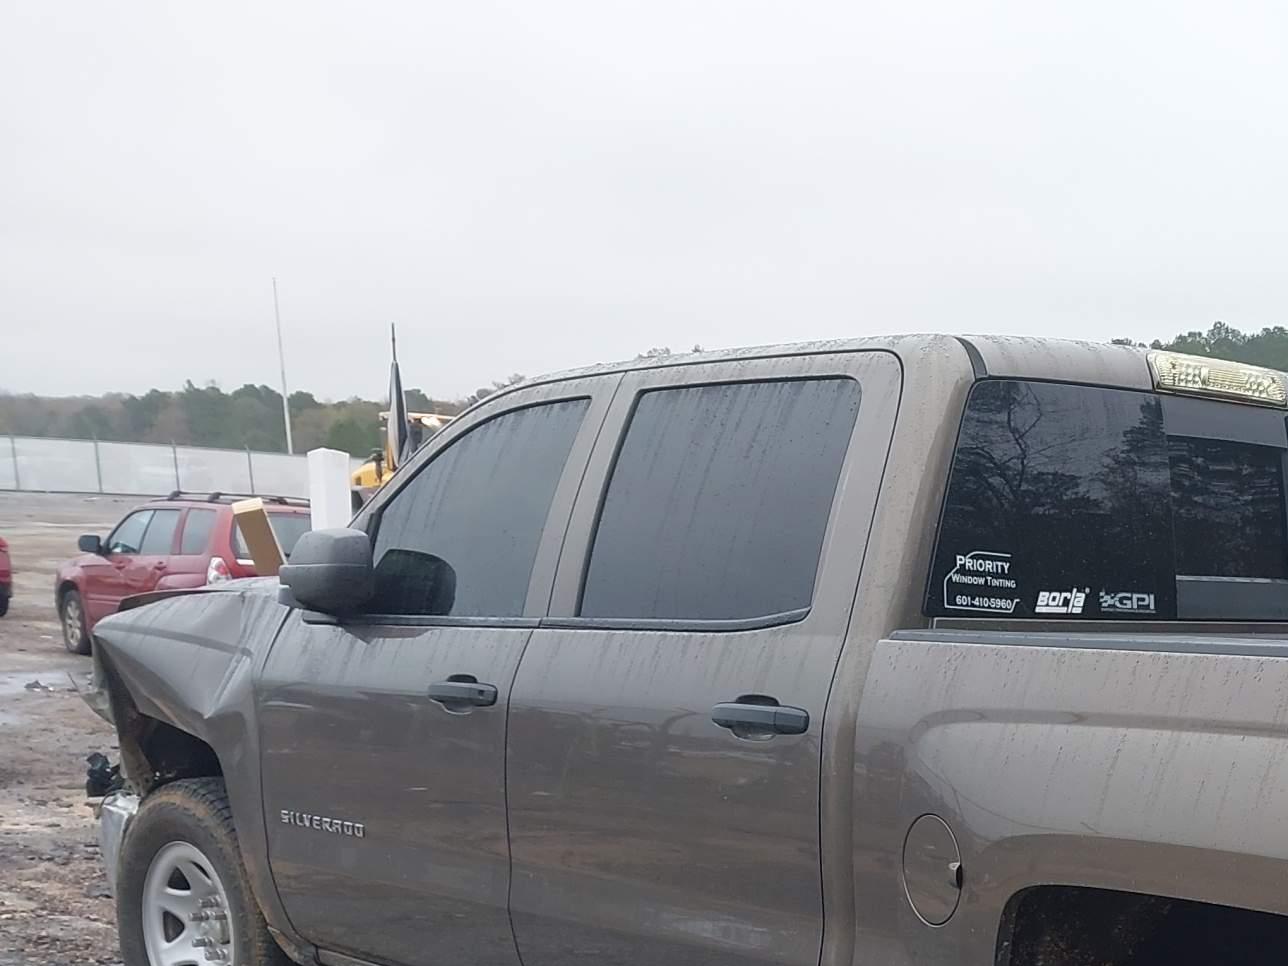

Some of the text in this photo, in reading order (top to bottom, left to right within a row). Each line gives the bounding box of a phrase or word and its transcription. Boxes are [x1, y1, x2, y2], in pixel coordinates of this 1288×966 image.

[956, 595, 1012, 609] 601-410-5960
[1115, 592, 1155, 610] GPI
[280, 809, 364, 837] SILVERADO
